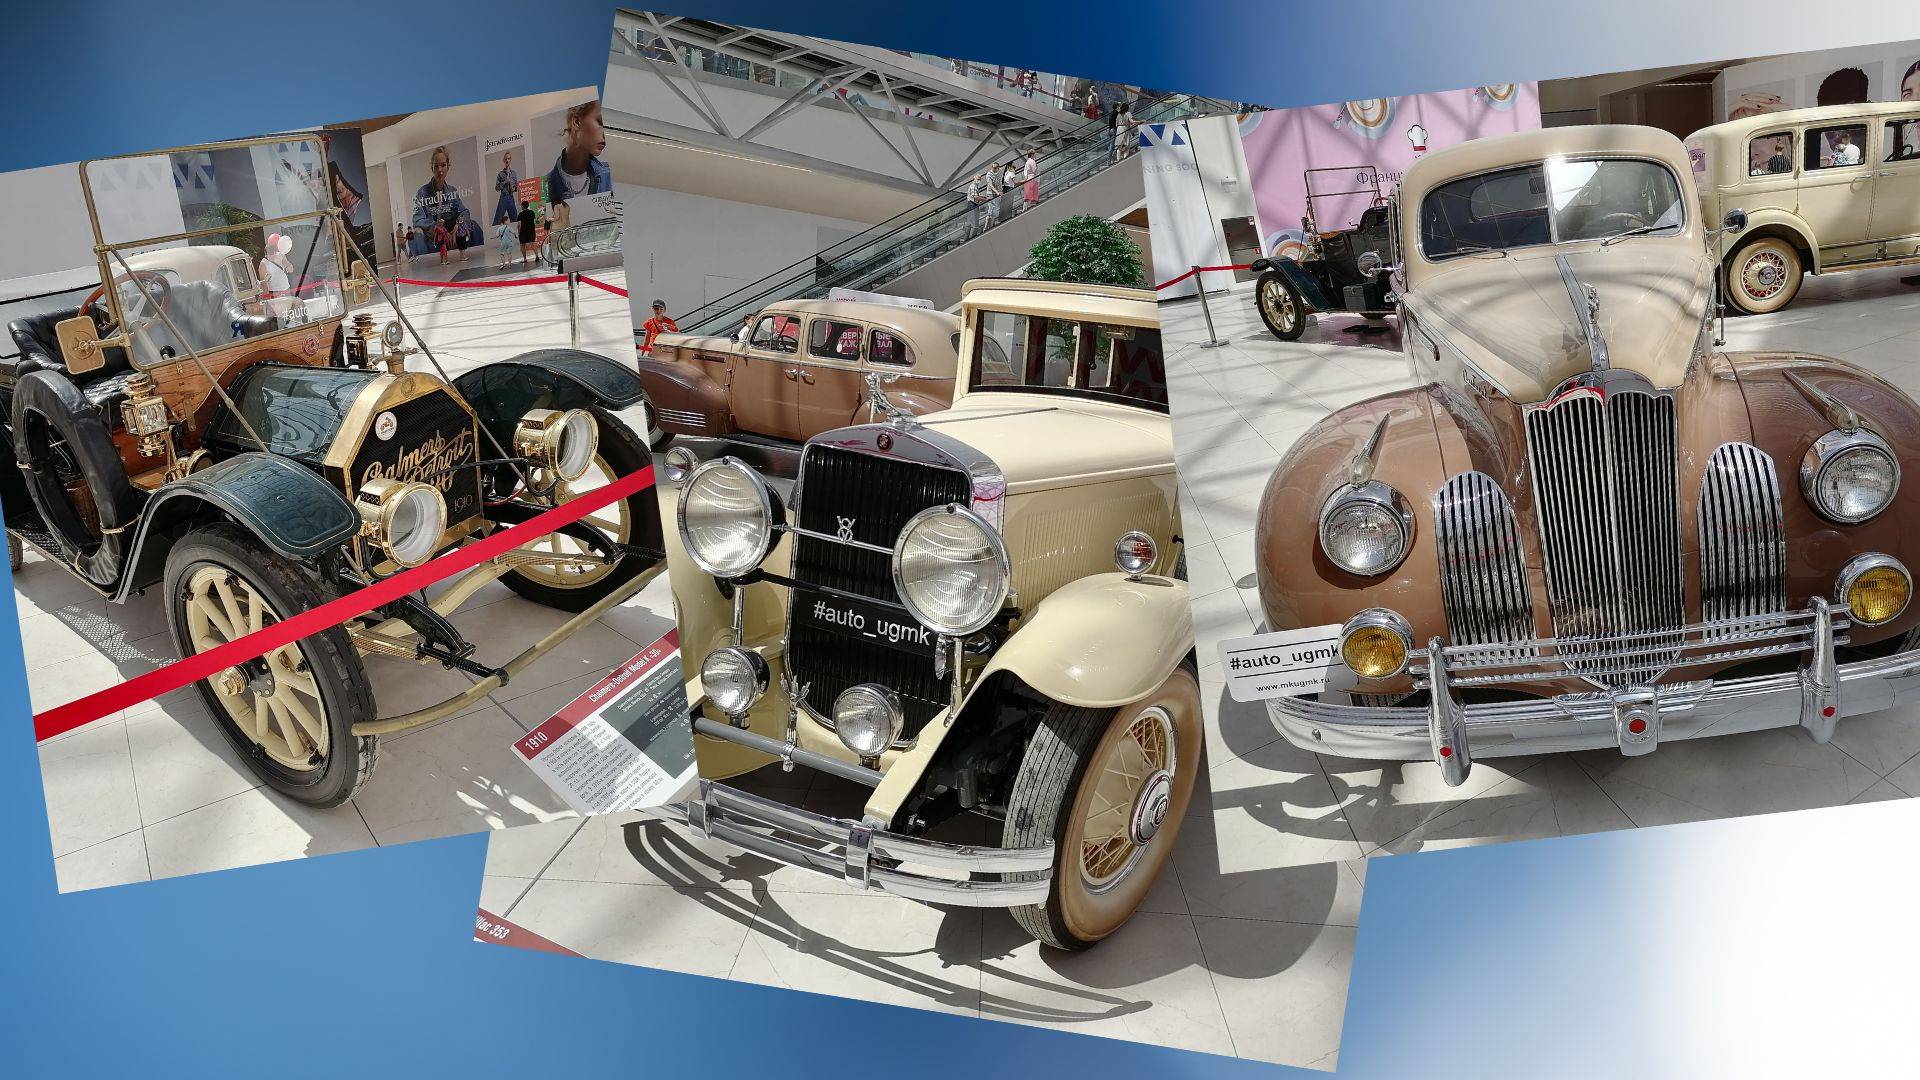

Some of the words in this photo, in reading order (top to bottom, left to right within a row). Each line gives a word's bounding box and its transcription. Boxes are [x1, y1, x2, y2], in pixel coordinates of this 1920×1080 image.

[814, 600, 931, 646] #auto_ugmk
[1230, 644, 1339, 671] #auto_ugmk
[1255, 677, 1331, 692] www.mkugmk.ru
[525, 731, 548, 751] 1910
[489, 924, 510, 939] 353
